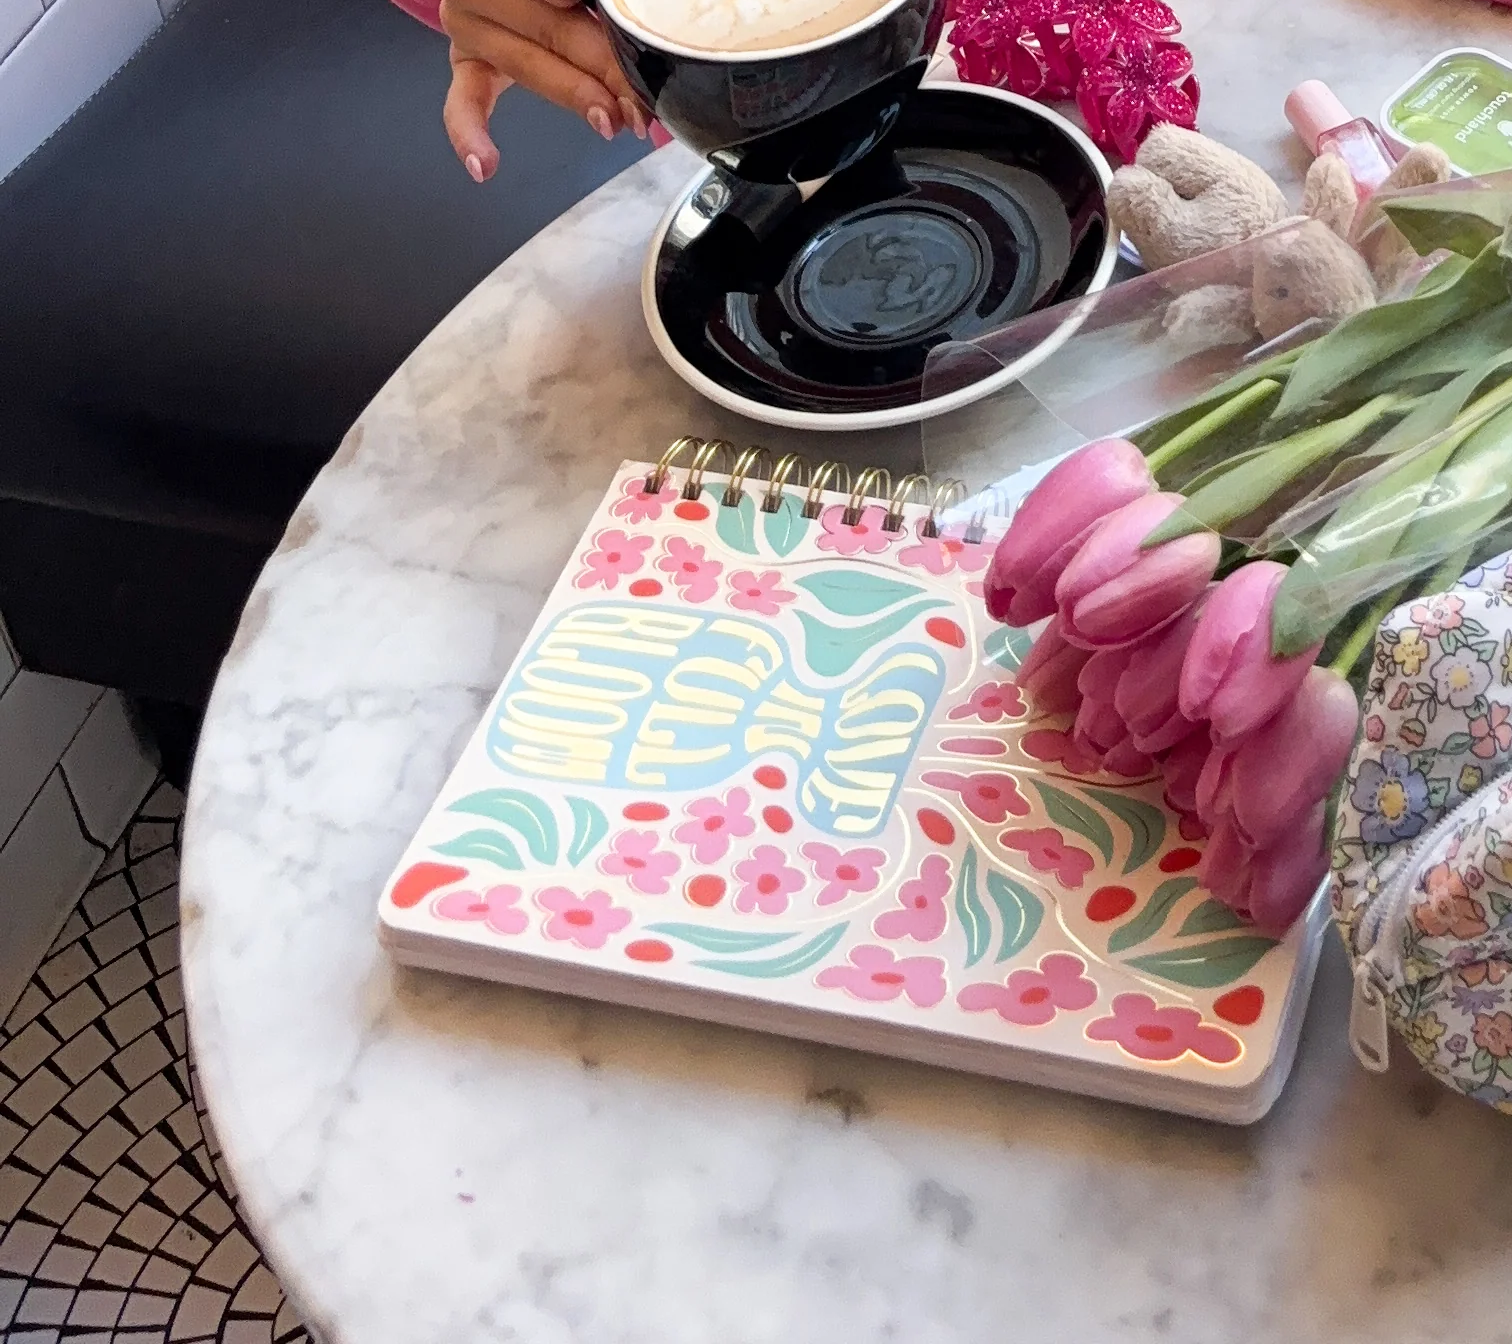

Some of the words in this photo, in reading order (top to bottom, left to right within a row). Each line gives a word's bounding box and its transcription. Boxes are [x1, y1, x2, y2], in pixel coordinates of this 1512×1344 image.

[492, 607, 705, 783] BLOOM
[625, 618, 785, 785] FULL
[744, 678, 826, 760] IN
[802, 652, 938, 832] LOVE
